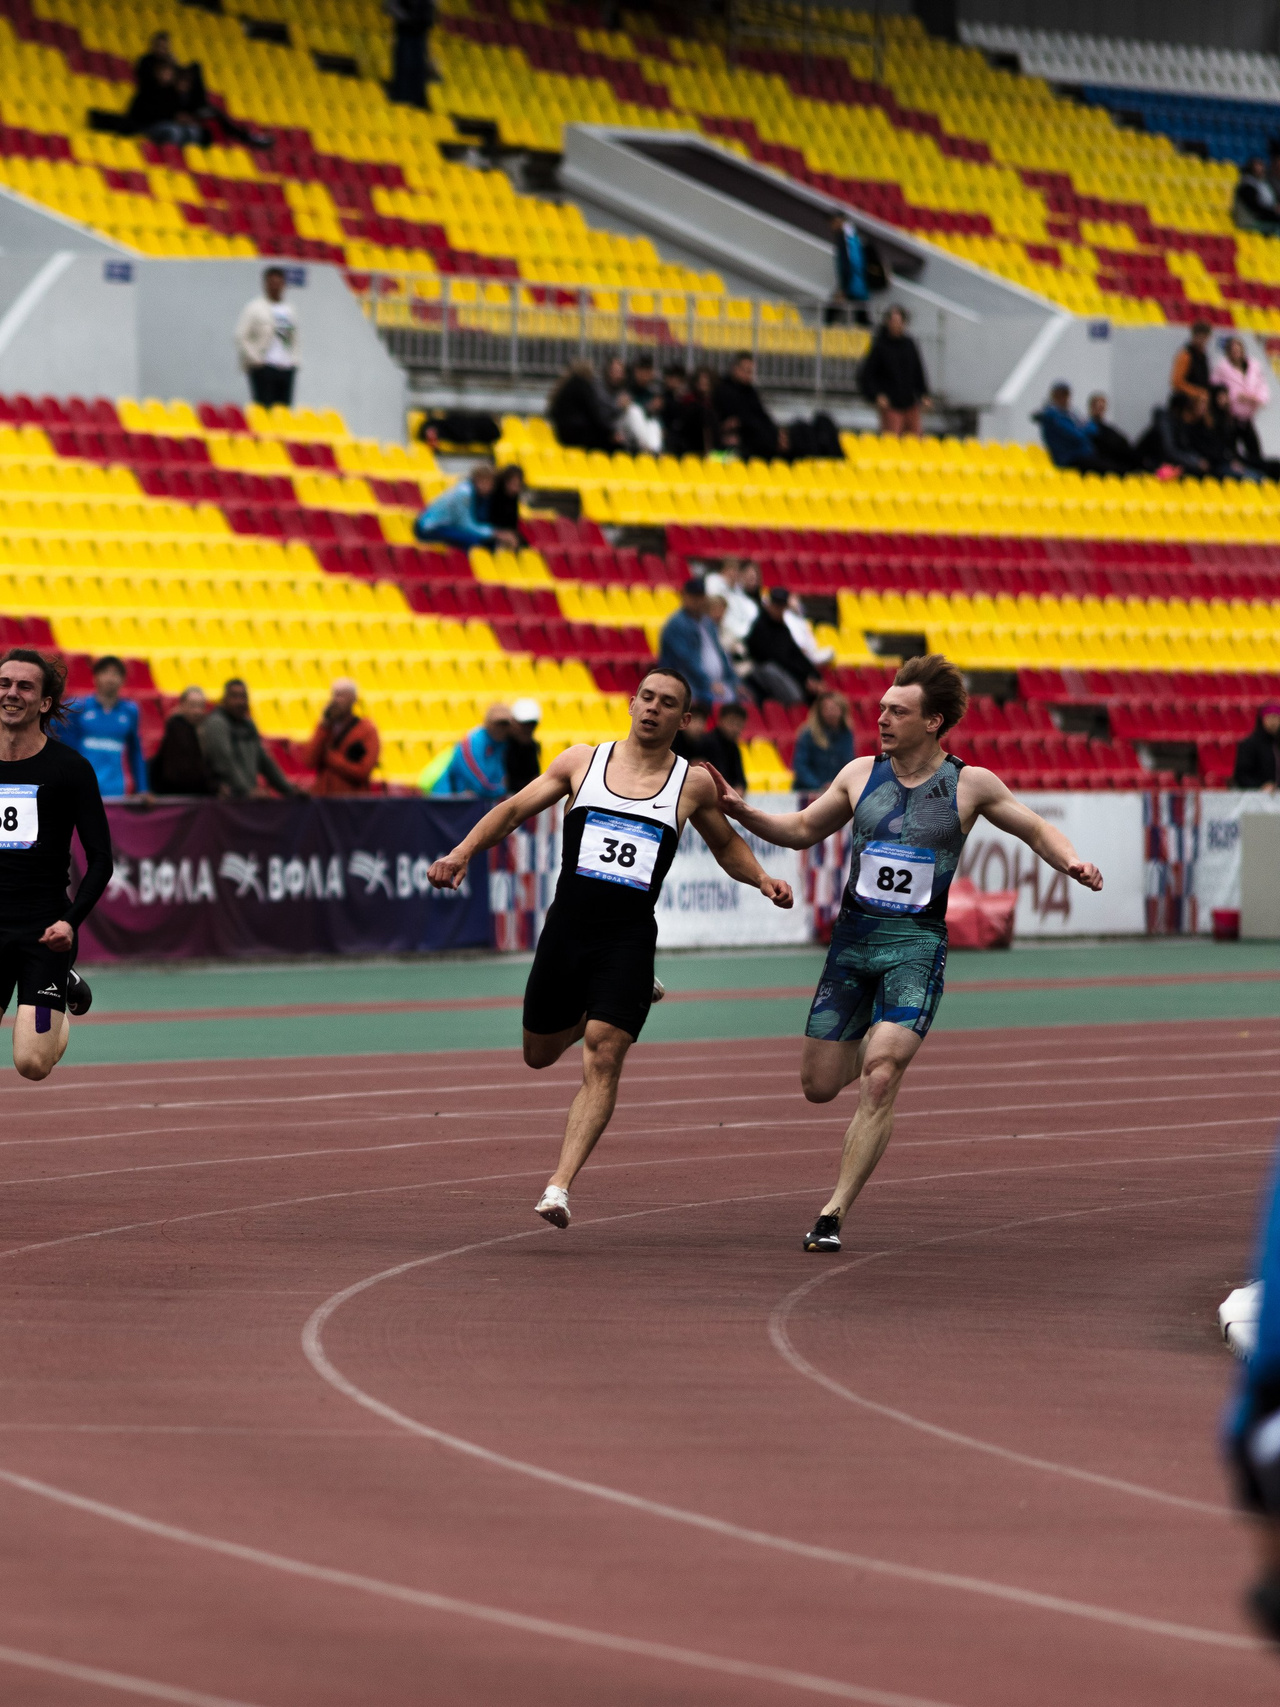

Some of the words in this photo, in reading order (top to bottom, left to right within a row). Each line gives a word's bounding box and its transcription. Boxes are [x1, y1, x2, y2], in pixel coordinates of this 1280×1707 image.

[598, 837, 637, 868] 38
[138, 857, 218, 904] ВФЛА
[268, 853, 344, 902] ВФЛА
[876, 866, 913, 895] 82
